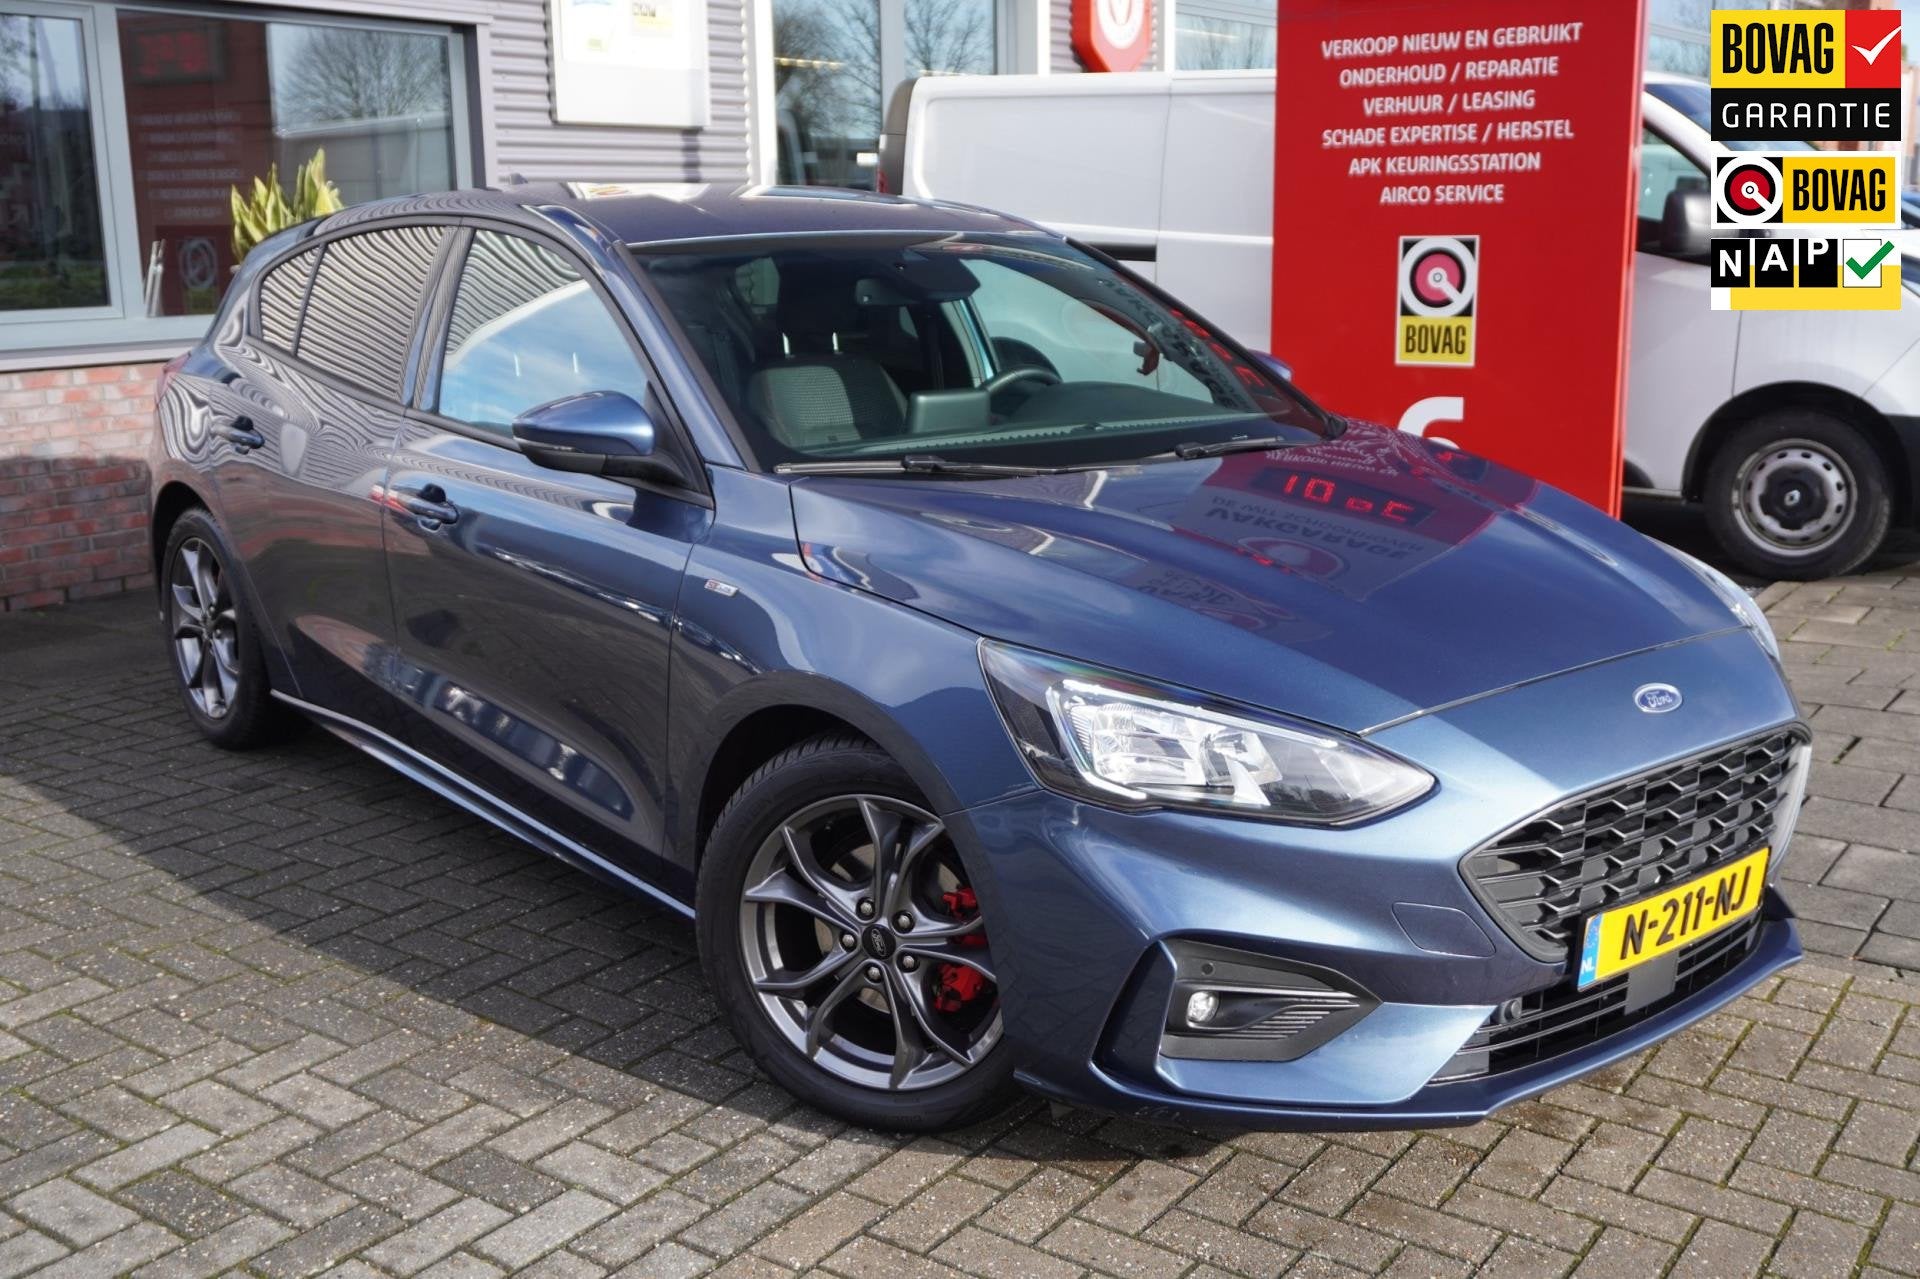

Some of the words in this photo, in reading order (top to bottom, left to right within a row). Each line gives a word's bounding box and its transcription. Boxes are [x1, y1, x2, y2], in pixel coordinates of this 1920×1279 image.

[1322, 36, 1398, 59] VERKOOP
[1403, 31, 1460, 52] NIEUW
[1465, 29, 1488, 47] EN
[1493, 22, 1583, 46] GEBRUIKT
[1340, 64, 1446, 88] ONDERHOUD
[1465, 56, 1559, 79] REPARATIE
[1363, 95, 1443, 116] VERHUUR
[1462, 89, 1535, 111] LEASING
[1322, 128, 1385, 147] SCHADE
[1390, 123, 1477, 145] EXPERTISE
[1497, 119, 1574, 140] HERSTEL
[1349, 157, 1381, 176] APK
[1386, 152, 1541, 174] KEURINGSSTATION
[1380, 186, 1430, 205] AIRCO
[1435, 184, 1504, 203] SERVICE
[1405, 324, 1466, 355] BOVAG
[1620, 866, 1751, 960] N-211-NJ
[1581, 957, 1595, 974] NL
